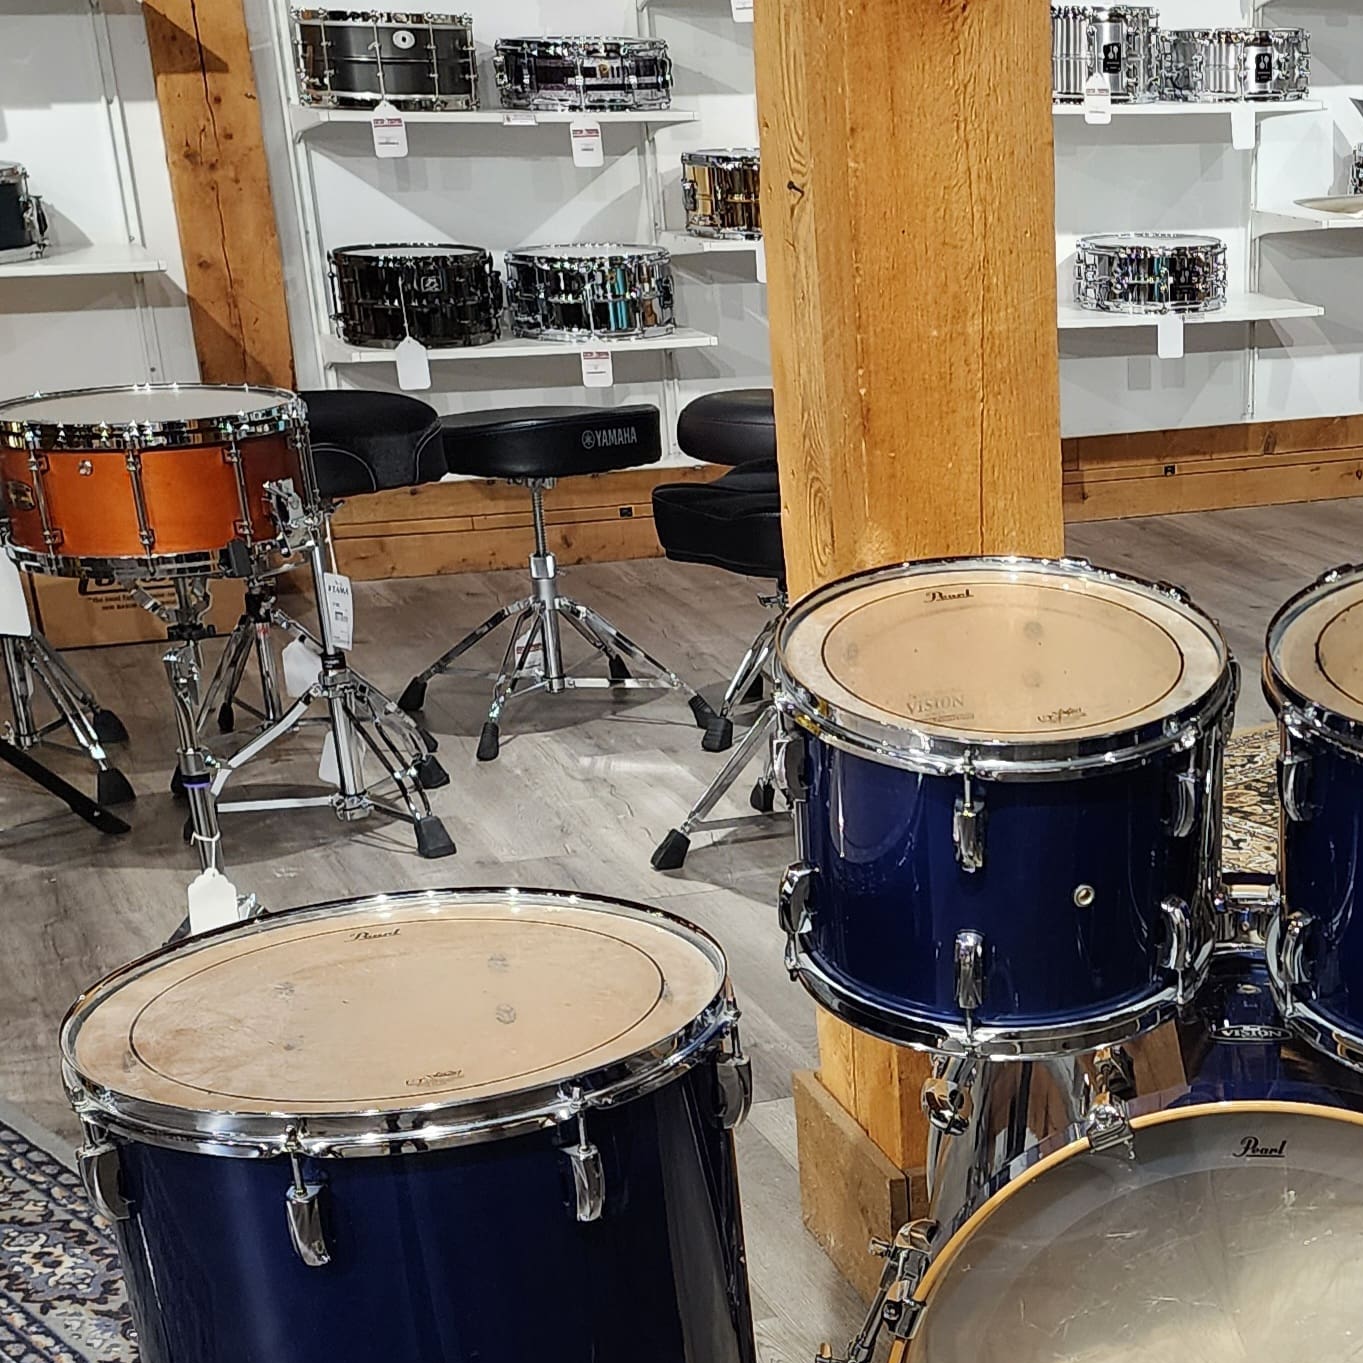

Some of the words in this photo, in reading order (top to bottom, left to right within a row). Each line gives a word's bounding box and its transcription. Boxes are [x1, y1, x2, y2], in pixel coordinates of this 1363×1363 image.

[595, 426, 637, 447] YAMAHA
[906, 694, 965, 715] VISION
[1221, 1028, 1282, 1038] VISION
[1232, 1136, 1287, 1157] Pearl
